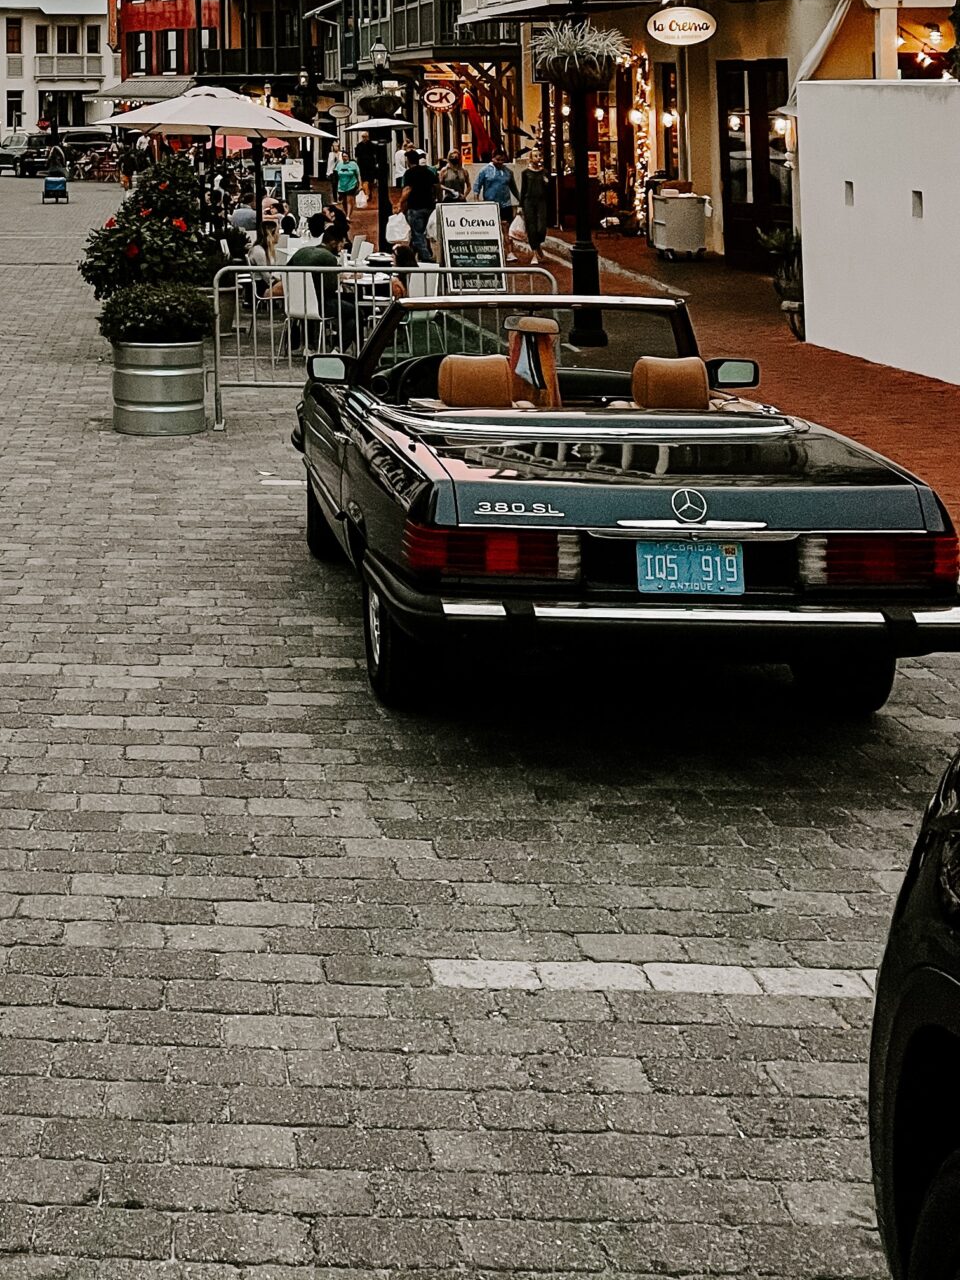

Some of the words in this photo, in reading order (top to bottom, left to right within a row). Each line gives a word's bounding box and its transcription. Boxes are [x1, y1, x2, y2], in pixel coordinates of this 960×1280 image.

[653, 20, 664, 31] la
[669, 20, 710, 31] Crema
[426, 92, 451, 103] CK
[460, 216, 495, 227] Crema
[478, 502, 525, 513] 380
[532, 503, 559, 513] SL
[701, 555, 737, 581] 919
[669, 582, 713, 591] ANTIQUE
